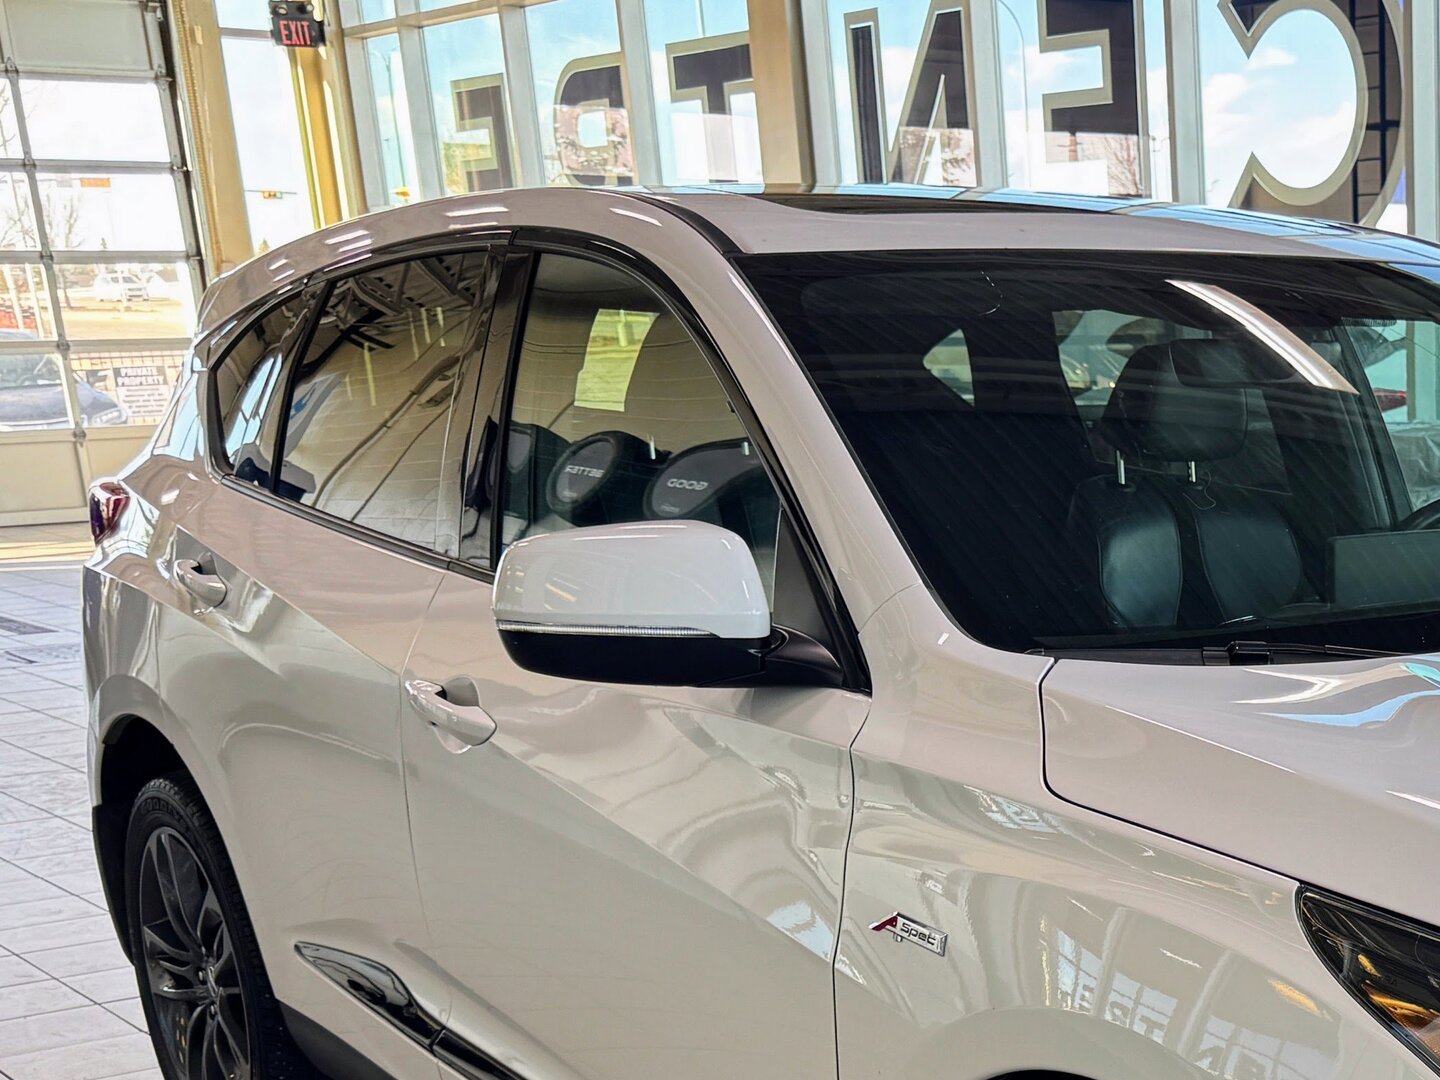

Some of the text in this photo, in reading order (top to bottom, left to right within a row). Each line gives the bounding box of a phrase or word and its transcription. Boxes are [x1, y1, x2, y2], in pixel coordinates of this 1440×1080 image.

[279, 20, 311, 45] EXIT
[120, 367, 160, 377] PRIVATE
[117, 376, 164, 387] PROPERTY
